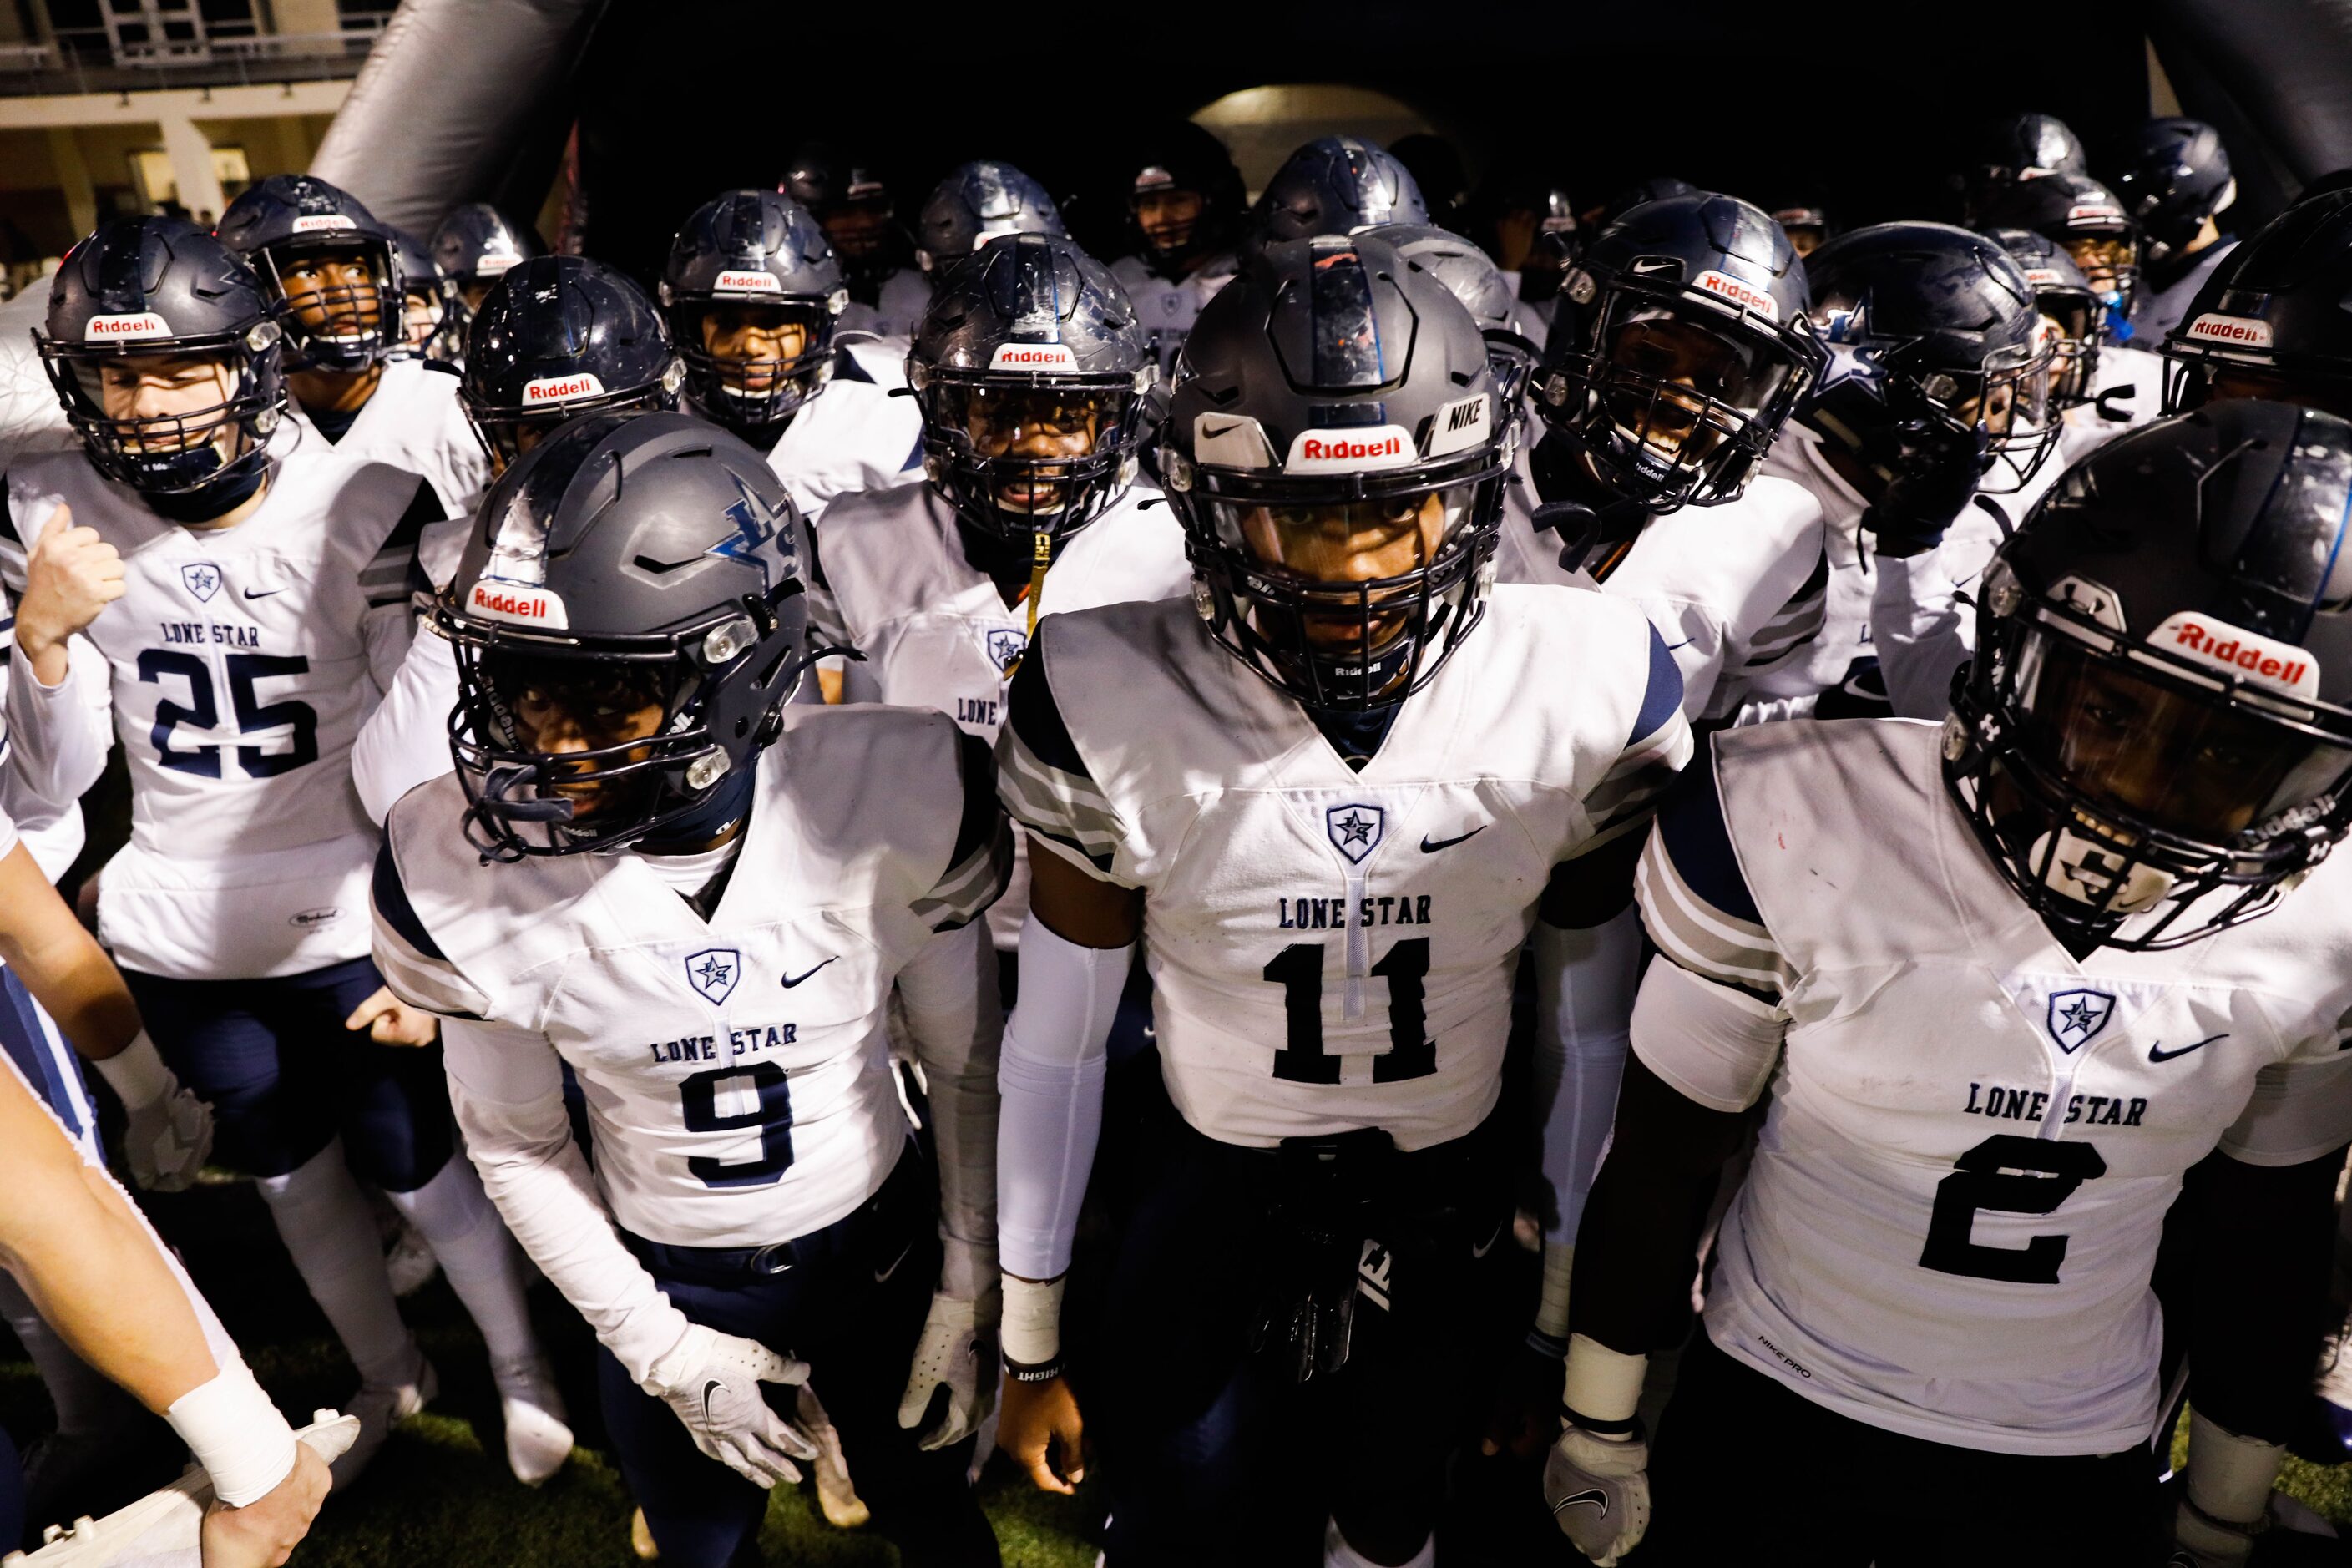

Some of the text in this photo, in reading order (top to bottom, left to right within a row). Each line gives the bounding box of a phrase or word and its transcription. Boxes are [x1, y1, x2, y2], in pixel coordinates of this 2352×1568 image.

[723, 275, 771, 287] Riddell
[1706, 276, 1771, 313] Riddell
[94, 319, 154, 332] Riddell
[2194, 322, 2258, 341] Riddell
[1002, 351, 1065, 362] Riddell
[529, 379, 590, 399] Riddell
[1448, 398, 1483, 432] NIKE
[1304, 437, 1400, 458] Riddell
[474, 588, 546, 617] Riddell
[161, 623, 260, 647] LONE STAR
[2177, 623, 2306, 685] Riddell
[138, 647, 318, 779] 25
[958, 698, 997, 726] LONE
[1279, 894, 1431, 929] LONE STAR
[1263, 936, 1438, 1085] 11
[650, 1024, 797, 1062] LONE STAR
[1964, 1082, 2147, 1126] LONE STAR
[678, 1060, 795, 1188] 9
[1919, 1134, 2107, 1284] 2
[1758, 1336, 1811, 1378] NIKE PRO
